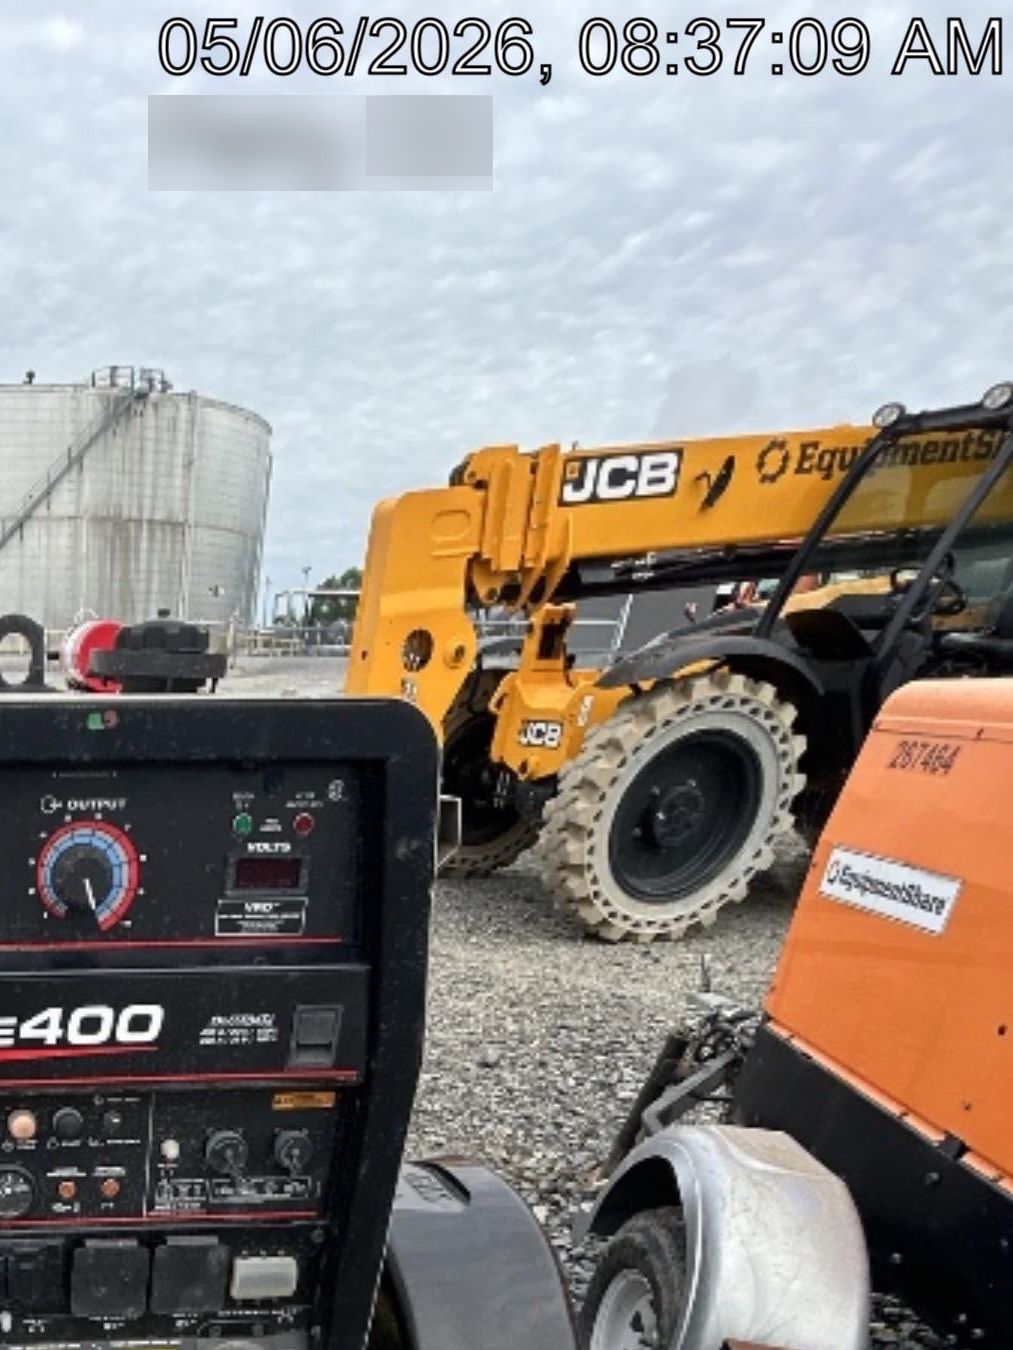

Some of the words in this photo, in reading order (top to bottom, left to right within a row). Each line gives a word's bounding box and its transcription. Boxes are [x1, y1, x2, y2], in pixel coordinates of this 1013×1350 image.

[794, 429, 1003, 480] EqumentS
[562, 452, 678, 502] JCB
[520, 722, 561, 748] JCB
[67, 798, 128, 811] OUTPUT
[247, 841, 292, 853] VOLTS
